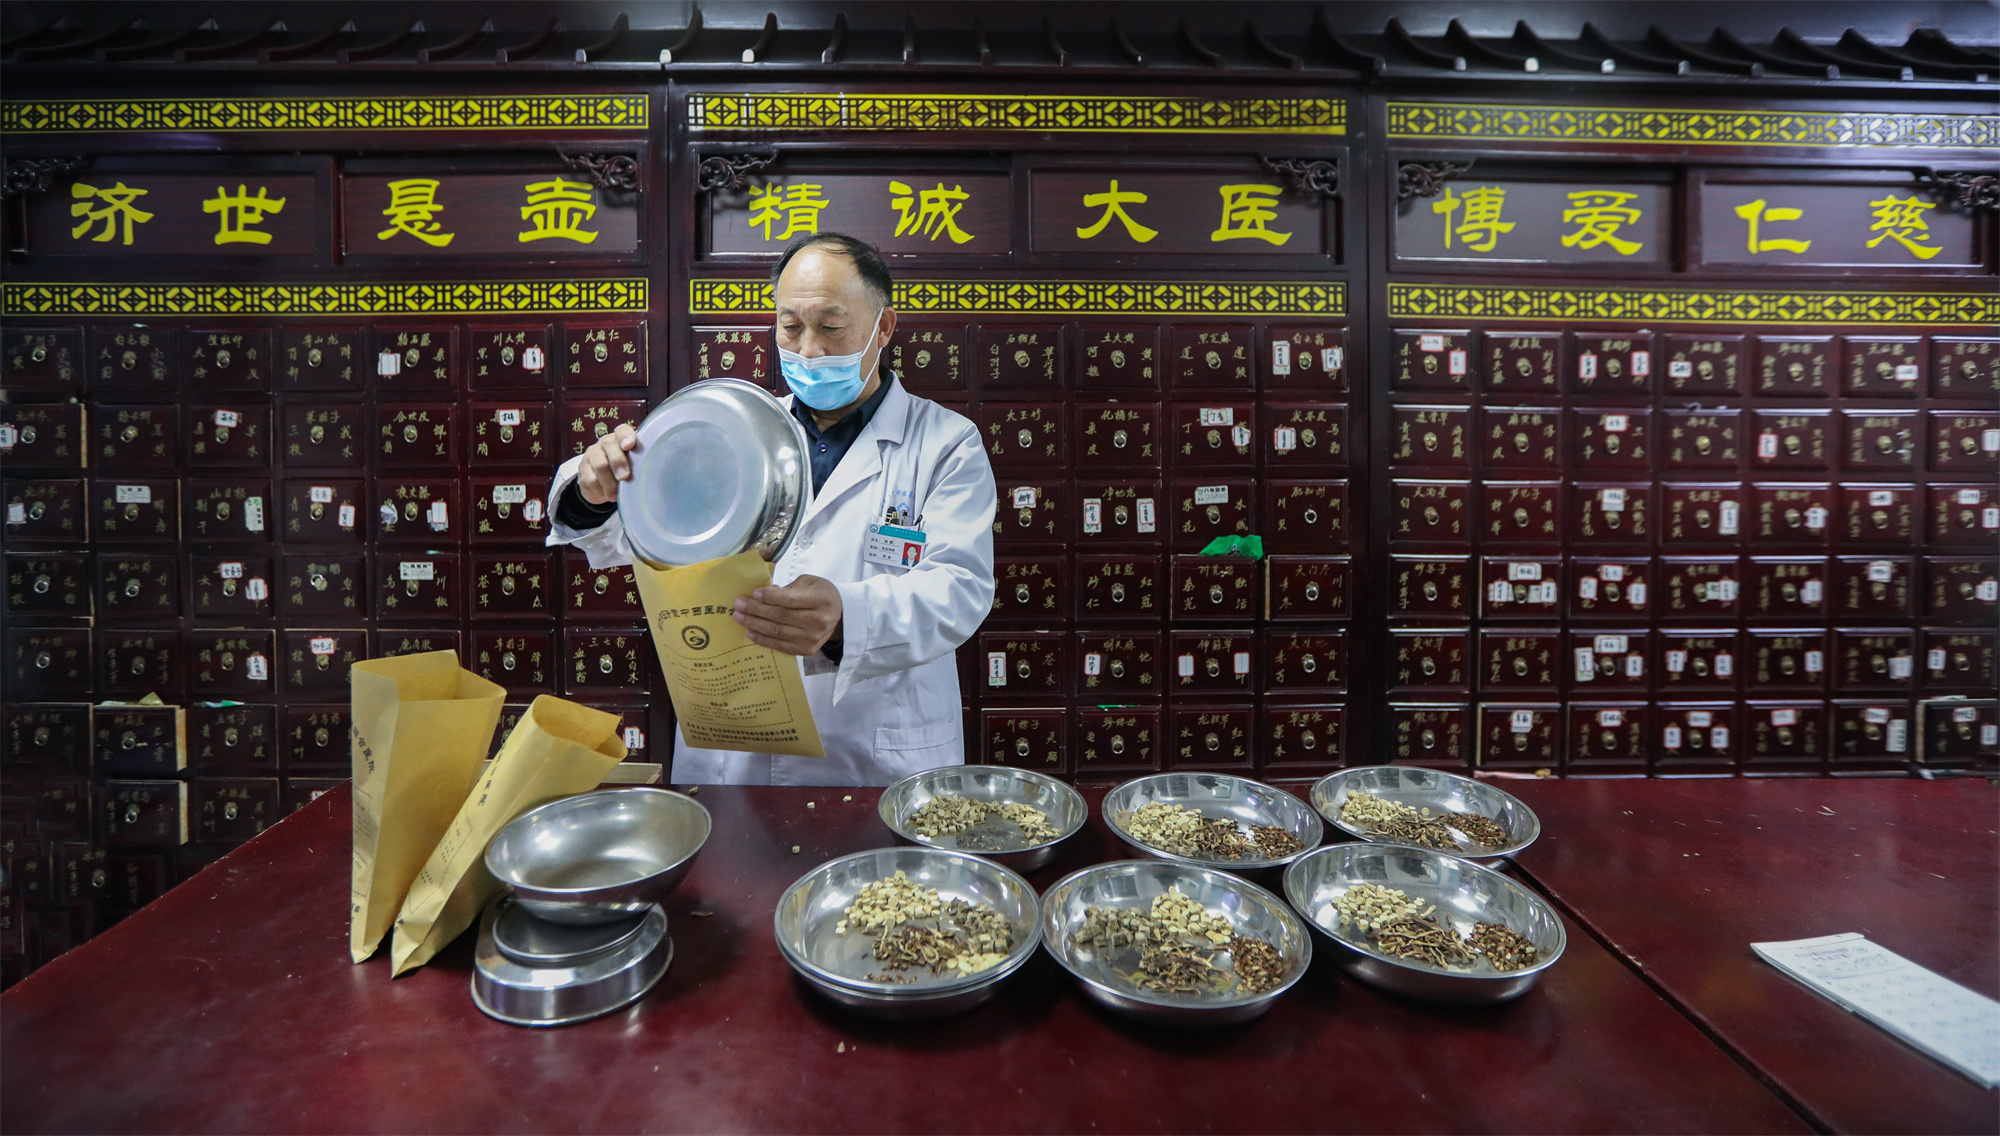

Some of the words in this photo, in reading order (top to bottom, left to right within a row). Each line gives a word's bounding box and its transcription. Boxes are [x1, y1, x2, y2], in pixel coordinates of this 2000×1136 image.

[71, 181, 286, 246] 济世
[377, 177, 599, 247] 悬壶
[749, 182, 975, 245] 精诚
[1077, 179, 1294, 247] 大医
[1433, 186, 1644, 256] 博爱
[1737, 193, 1943, 260] 仁慈
